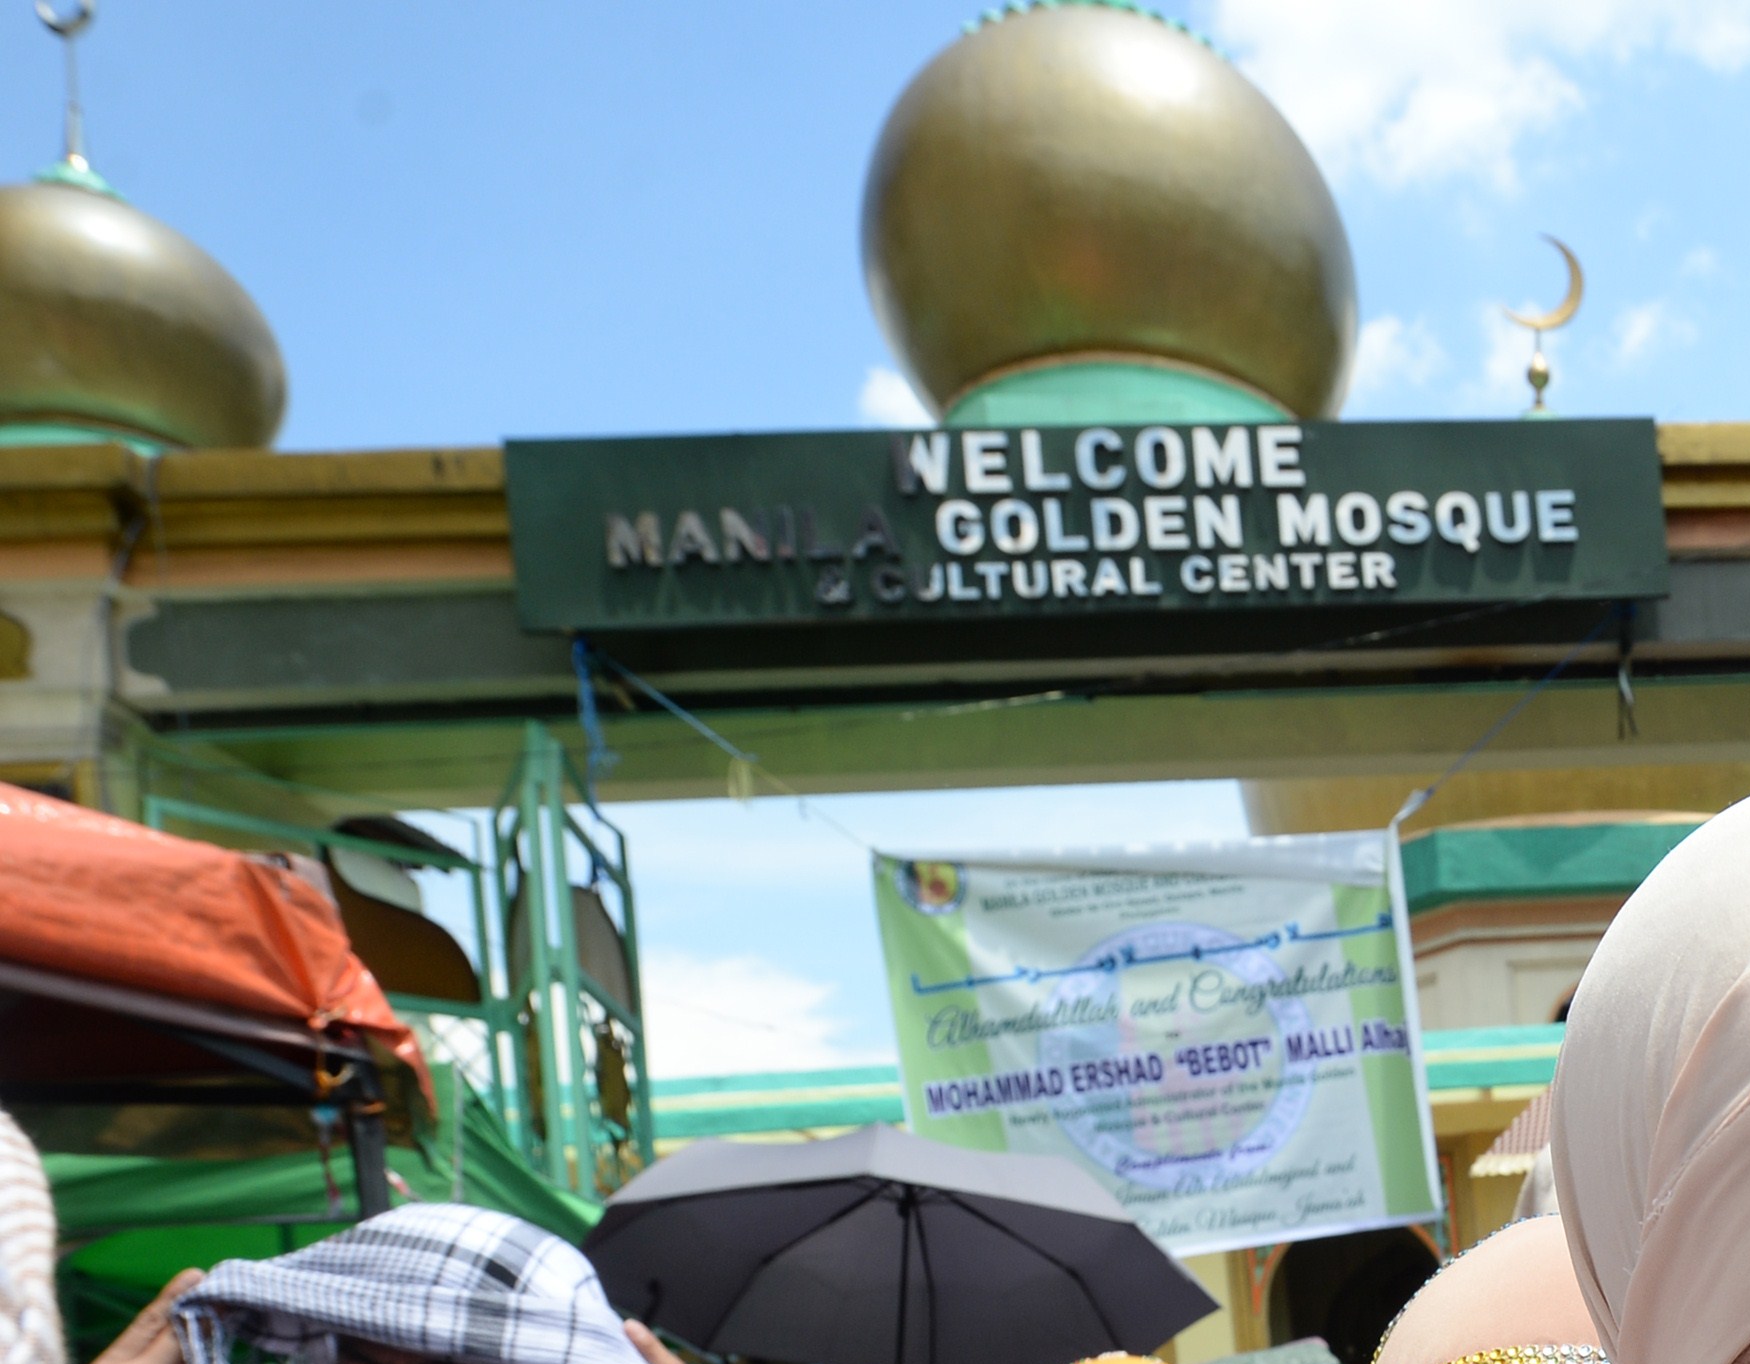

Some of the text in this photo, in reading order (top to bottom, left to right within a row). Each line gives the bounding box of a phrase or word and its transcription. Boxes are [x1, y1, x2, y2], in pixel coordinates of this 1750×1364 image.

[892, 425, 1306, 497] WELCOME
[606, 489, 1580, 569] MANILA GOLDEN MOSQUE
[812, 550, 1397, 605] & CULTURAL CENTER
[1130, 981, 1181, 1016] and
[1190, 962, 1396, 1015] Congratulations
[928, 1067, 1064, 1112] MOHAMMAD
[1071, 1054, 1163, 1092] ERSHAD
[1176, 1036, 1271, 1077] “BEBOT”
[1286, 1023, 1354, 1063] MALLI
